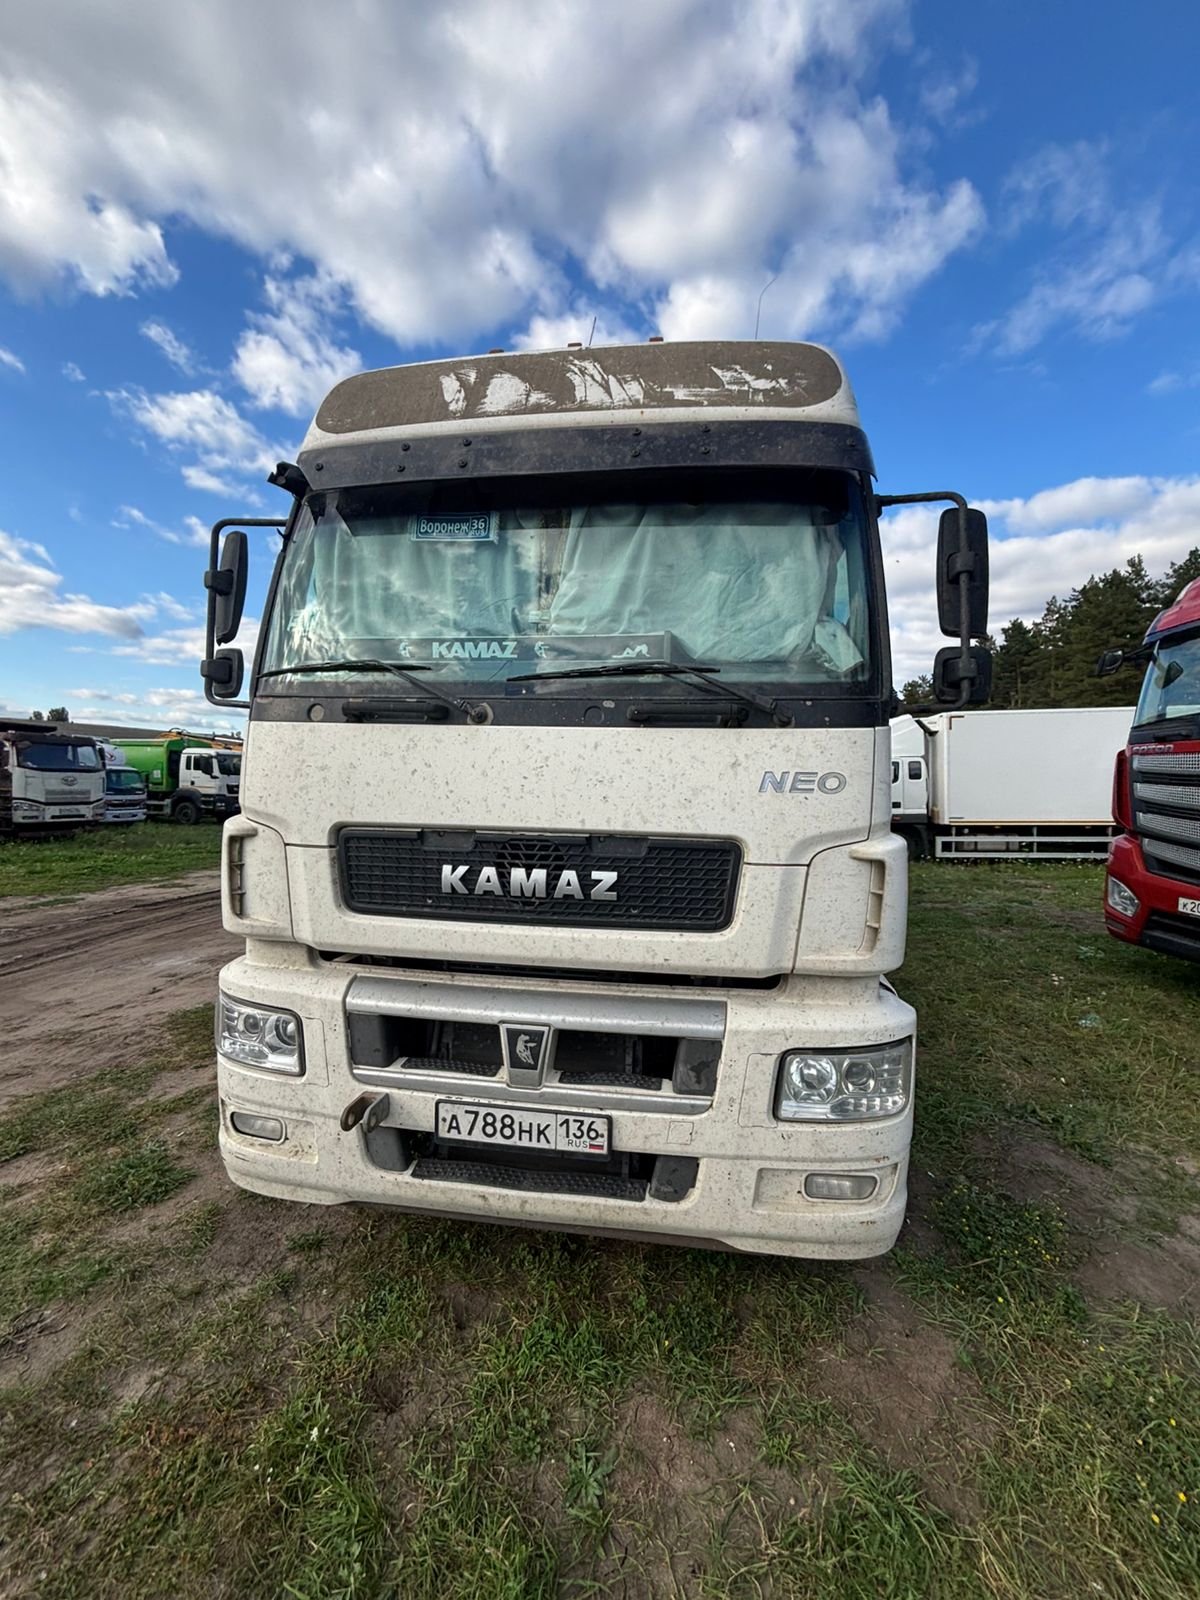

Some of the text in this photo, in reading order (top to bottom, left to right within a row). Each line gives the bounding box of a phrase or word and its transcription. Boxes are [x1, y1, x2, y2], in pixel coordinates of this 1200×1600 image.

[420, 518, 485, 535] Воронеж 36
[431, 641, 518, 658] KAMAZ
[758, 770, 847, 795] NEO
[441, 864, 618, 901] KAMAZ
[558, 1118, 600, 1141] 136
[567, 1138, 588, 1149] RUS
